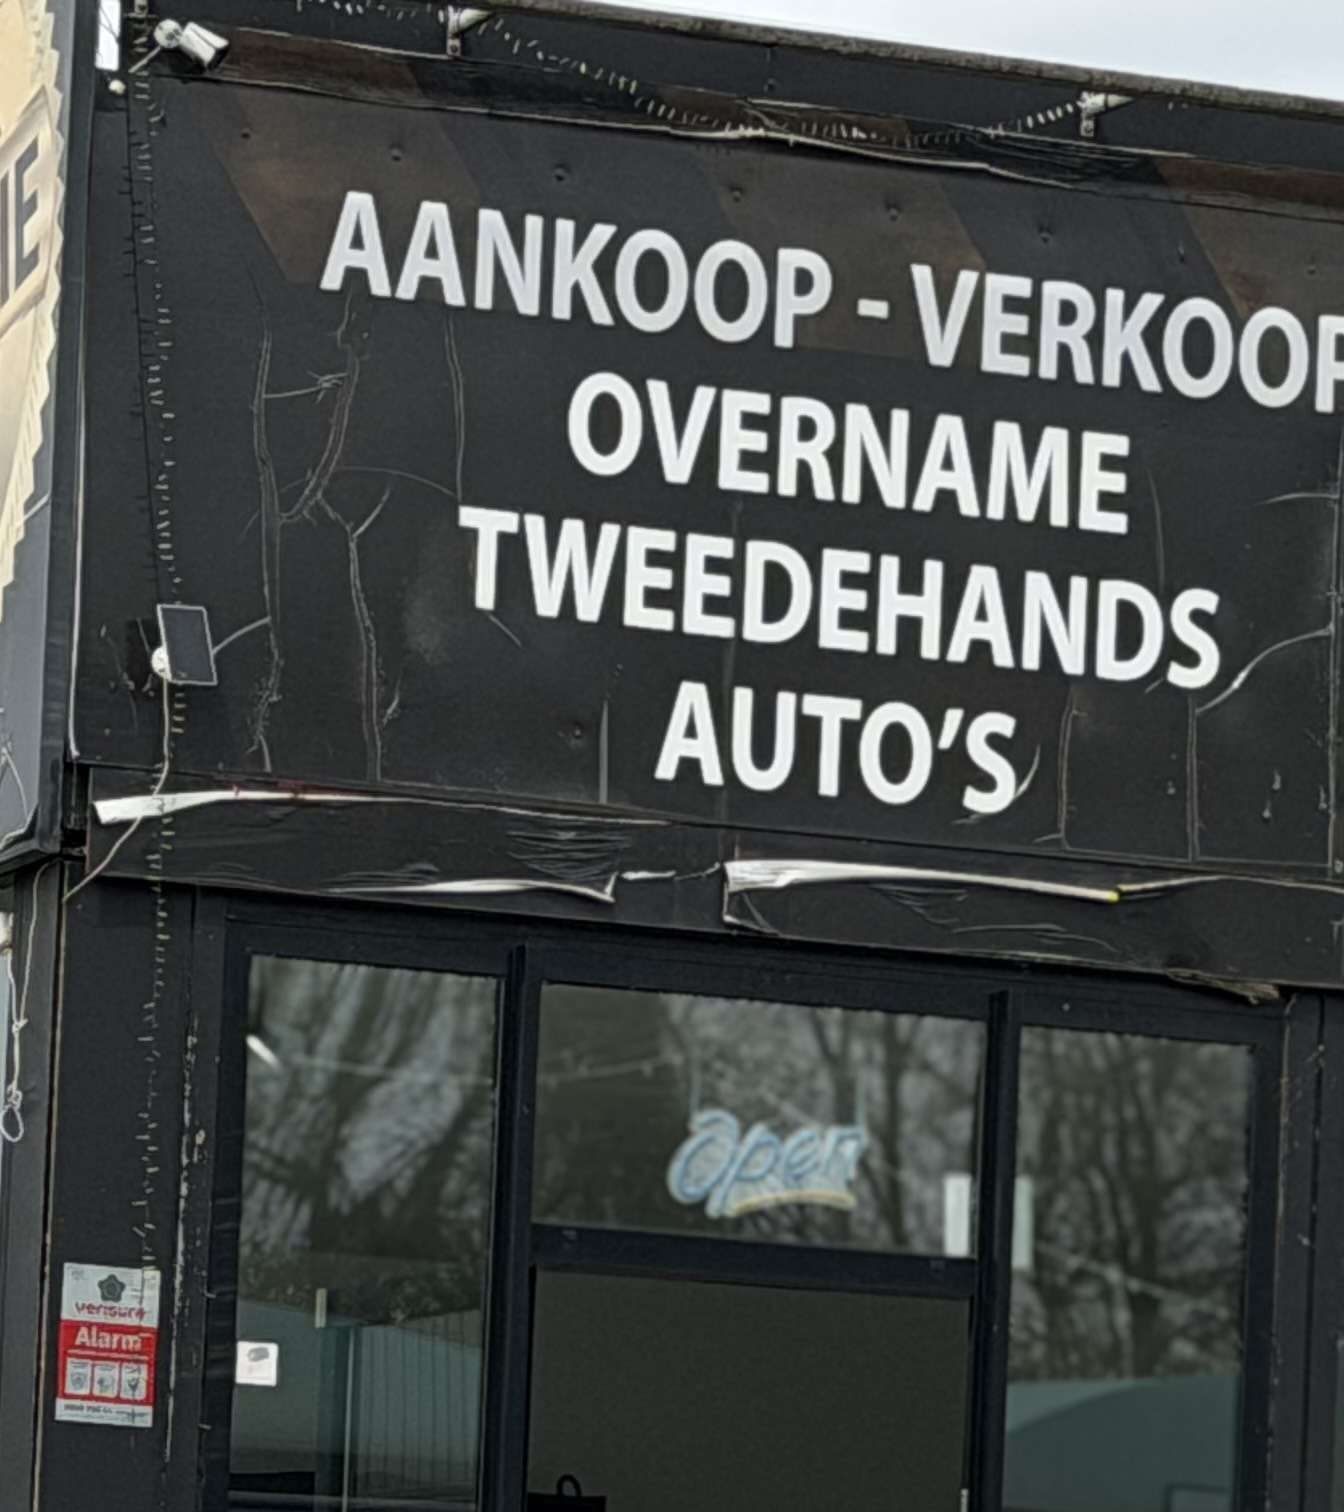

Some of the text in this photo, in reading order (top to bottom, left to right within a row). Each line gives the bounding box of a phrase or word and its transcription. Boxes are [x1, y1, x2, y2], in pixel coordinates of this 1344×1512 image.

[319, 190, 832, 348] AANKOOP
[568, 372, 1130, 534] OVERNAME
[458, 505, 1221, 689] TWEEDEHANDS
[654, 681, 1016, 813] AUTO'S
[666, 1108, 867, 1219] Open
[75, 1326, 142, 1350] Alarm
